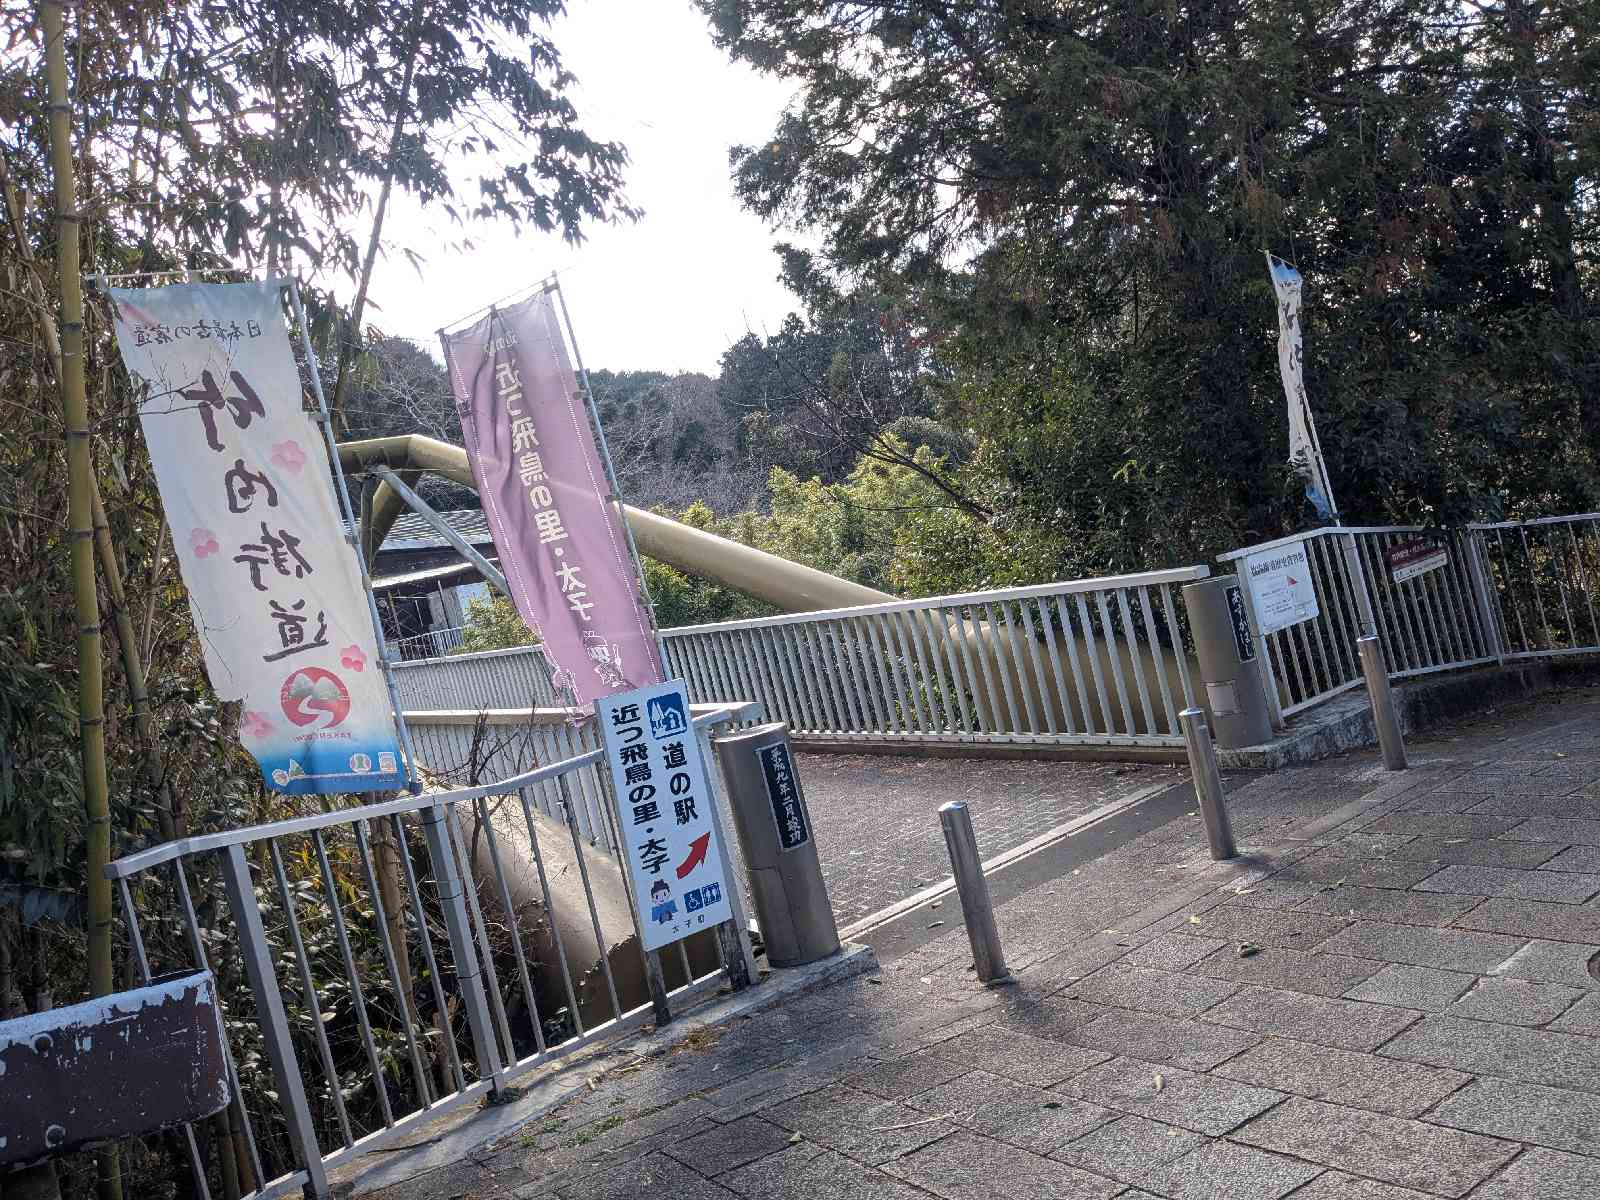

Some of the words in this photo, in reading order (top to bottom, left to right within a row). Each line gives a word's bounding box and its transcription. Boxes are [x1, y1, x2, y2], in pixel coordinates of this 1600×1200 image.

[611, 703, 671, 875] 近つ飛鳥の里・太子
[662, 740, 699, 826] 道の駅
